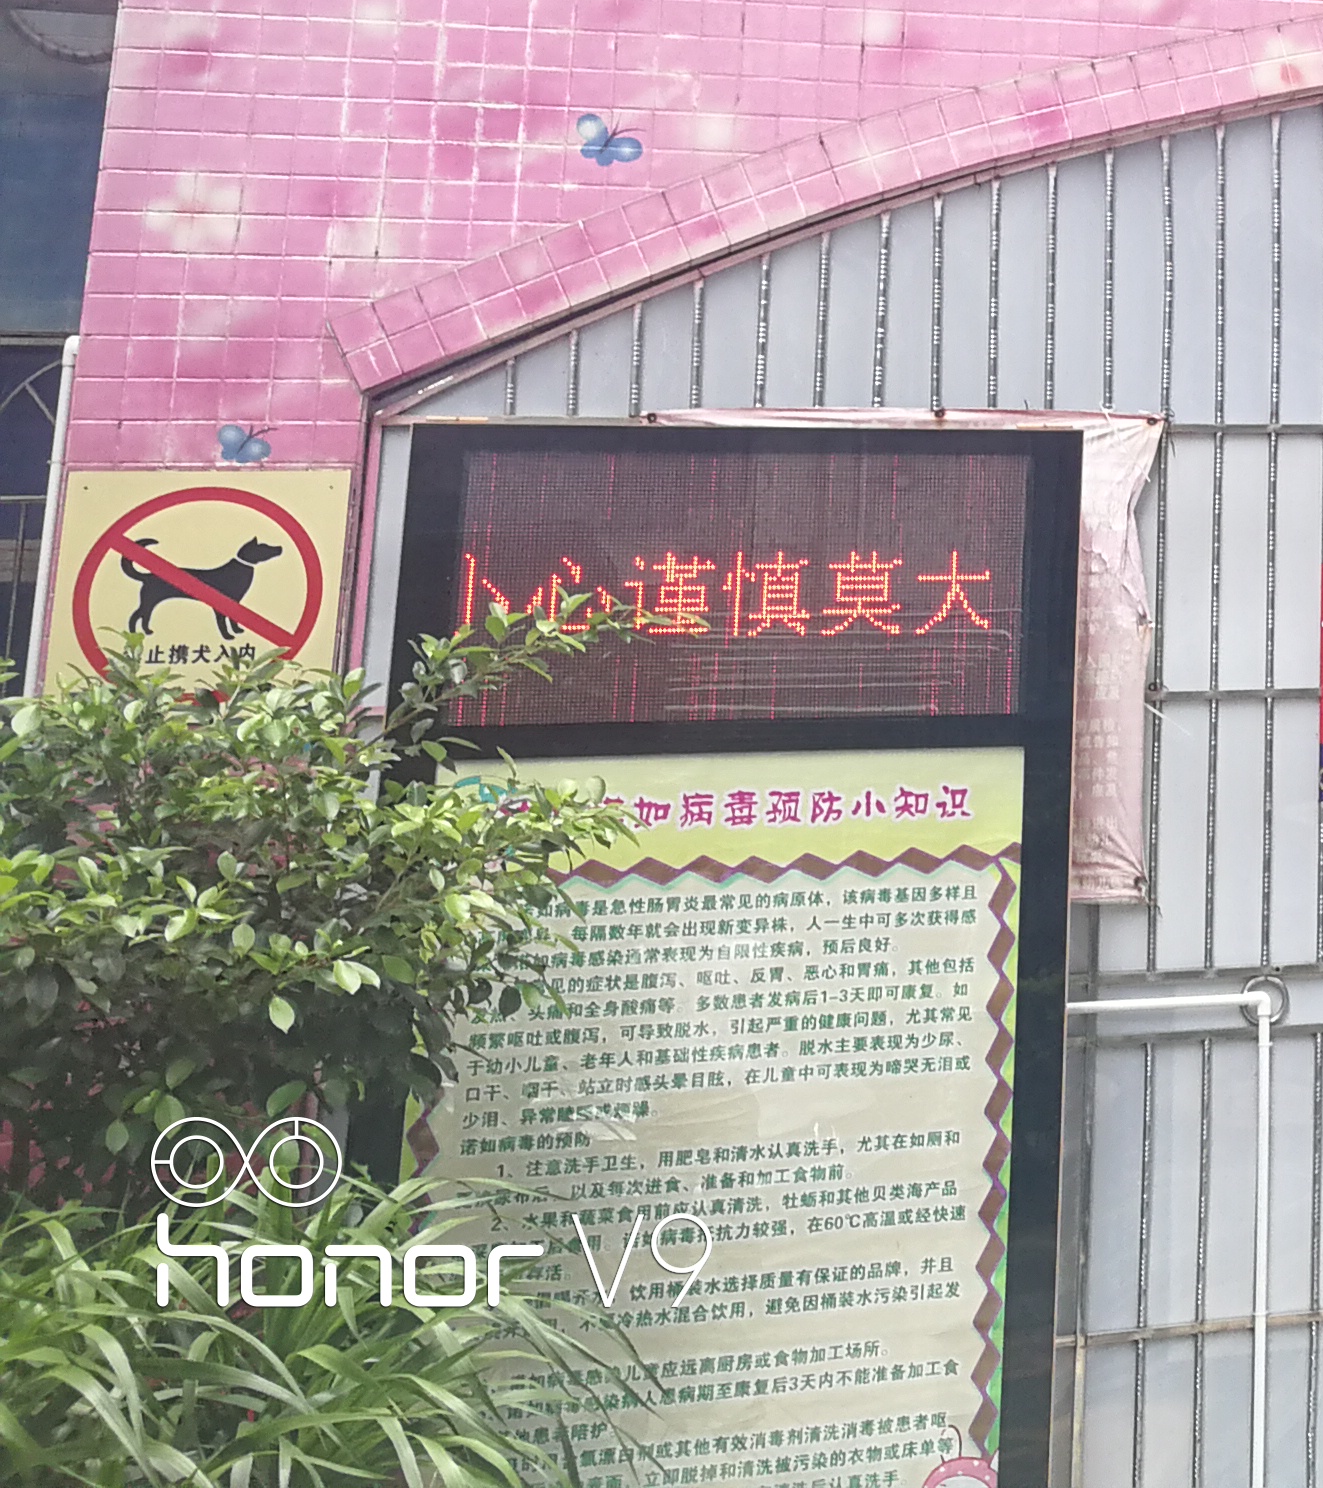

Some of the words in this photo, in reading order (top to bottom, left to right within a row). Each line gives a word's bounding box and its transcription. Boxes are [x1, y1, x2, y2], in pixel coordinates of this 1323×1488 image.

[124, 643, 256, 665] 止携犬入内
[500, 784, 974, 830] 如病毒预防小知识
[460, 1131, 591, 1155] 诺如病毒的预防
